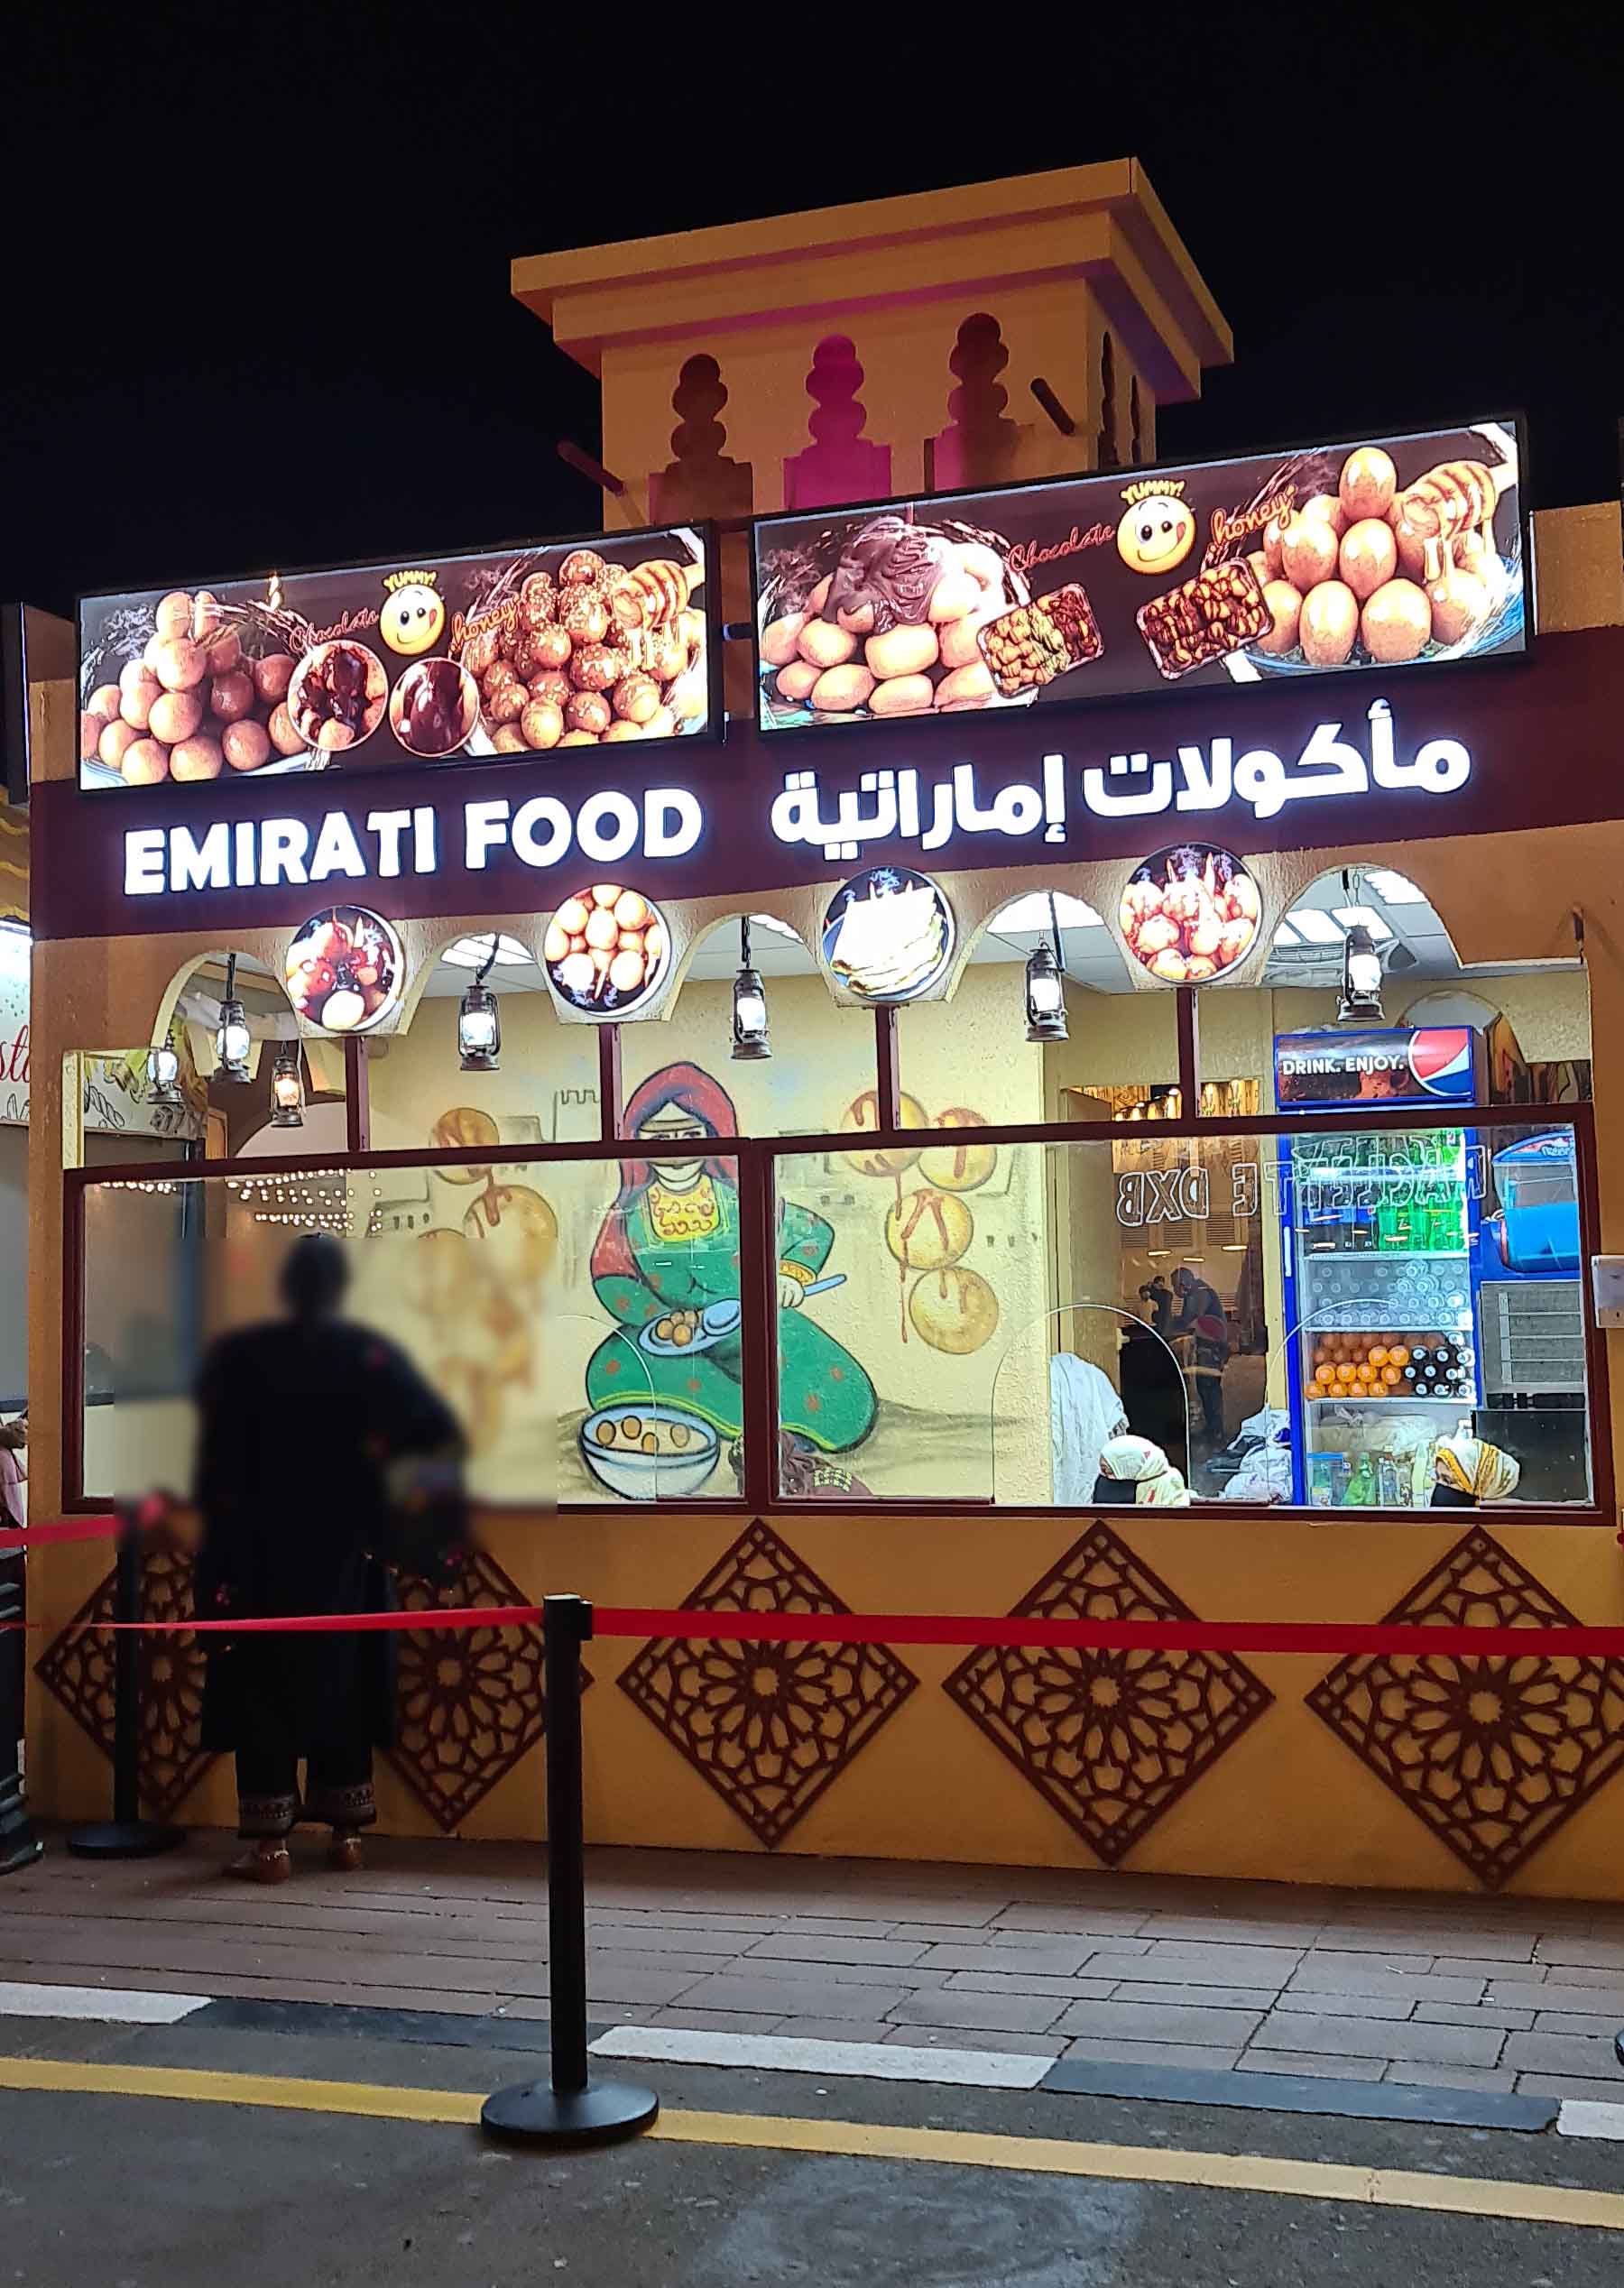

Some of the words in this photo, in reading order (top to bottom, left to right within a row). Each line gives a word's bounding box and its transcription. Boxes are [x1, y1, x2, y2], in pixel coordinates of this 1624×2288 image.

[1120, 479, 1186, 505] YUMMY!
[1006, 521, 1116, 573] Chocolate
[383, 570, 437, 593] YUMMY!
[1081, 697, 1472, 820] مأكولات
[769, 753, 1066, 861] إماراتية
[123, 806, 438, 895] EMIRATI
[464, 788, 703, 871] FOOD
[1282, 1059, 1342, 1076] DRINK.
[1345, 1054, 1405, 1075] ENJOY.
